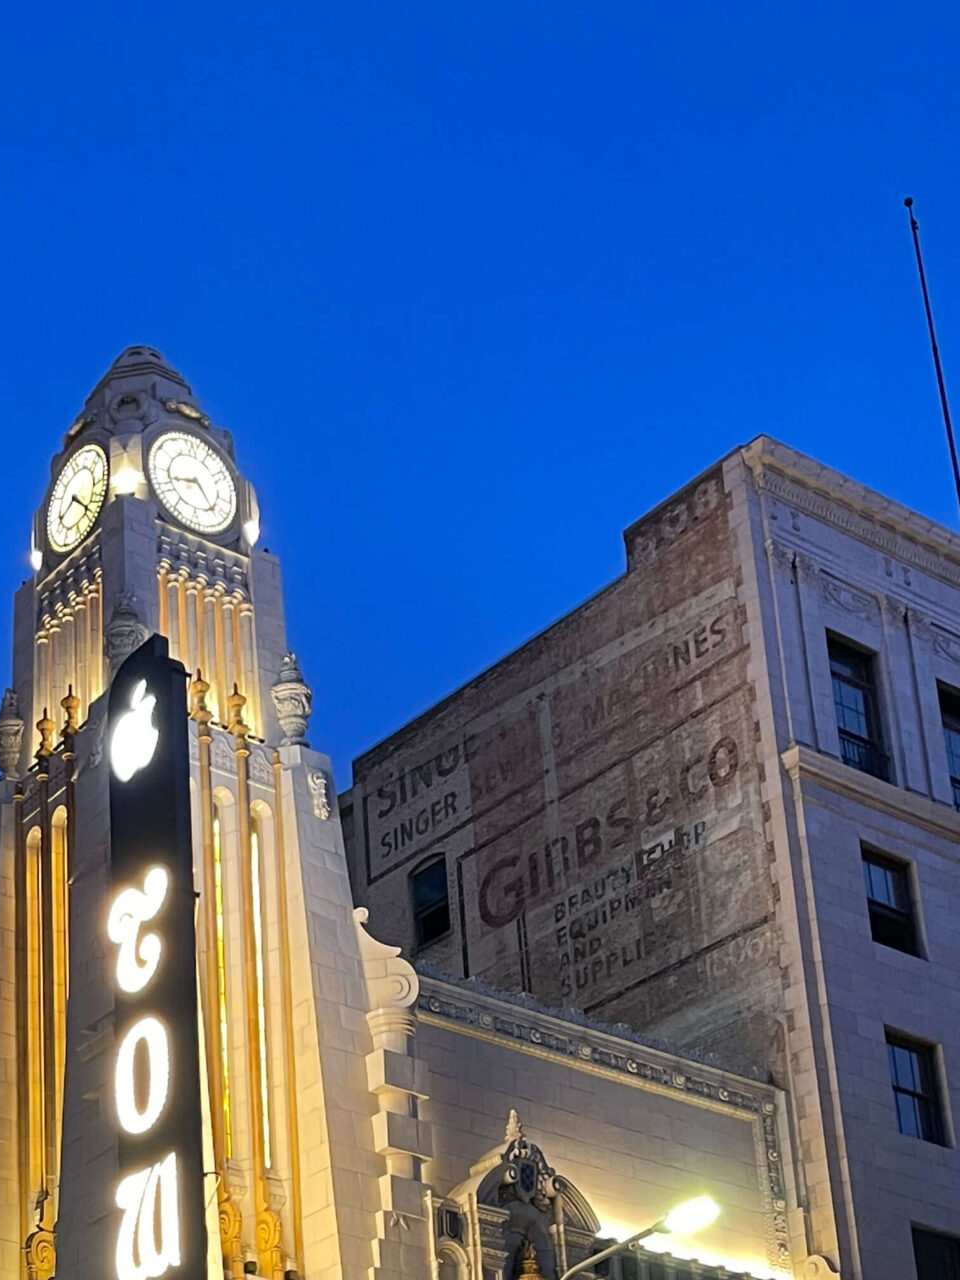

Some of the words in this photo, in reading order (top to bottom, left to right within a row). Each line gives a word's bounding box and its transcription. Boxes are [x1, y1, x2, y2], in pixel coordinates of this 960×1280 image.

[381, 791, 457, 858] SINGER
[478, 797, 636, 929] GIBBS
[559, 937, 602, 972] AND
